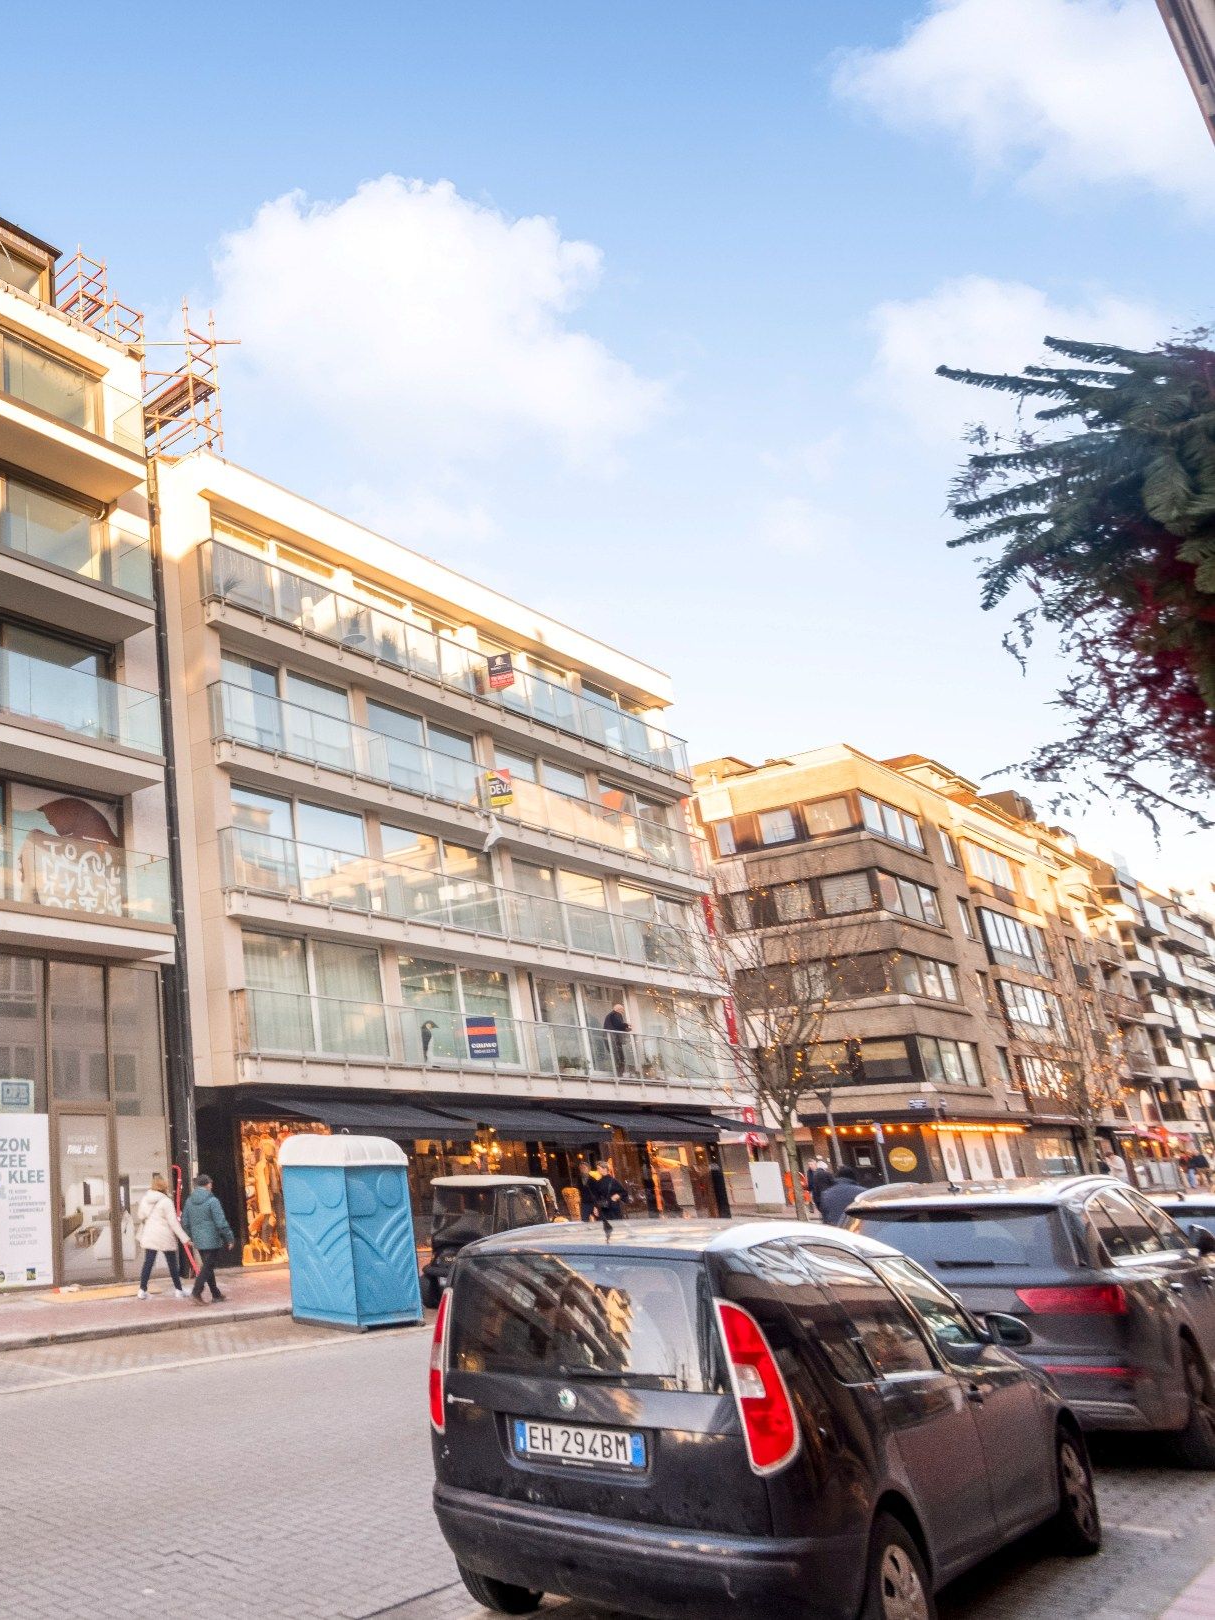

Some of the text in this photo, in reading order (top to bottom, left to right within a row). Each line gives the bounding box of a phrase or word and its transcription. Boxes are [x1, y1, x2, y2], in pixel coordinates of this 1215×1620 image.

[8, 1169, 45, 1184] KLEE
[528, 1426, 628, 1460] EH 294BM
